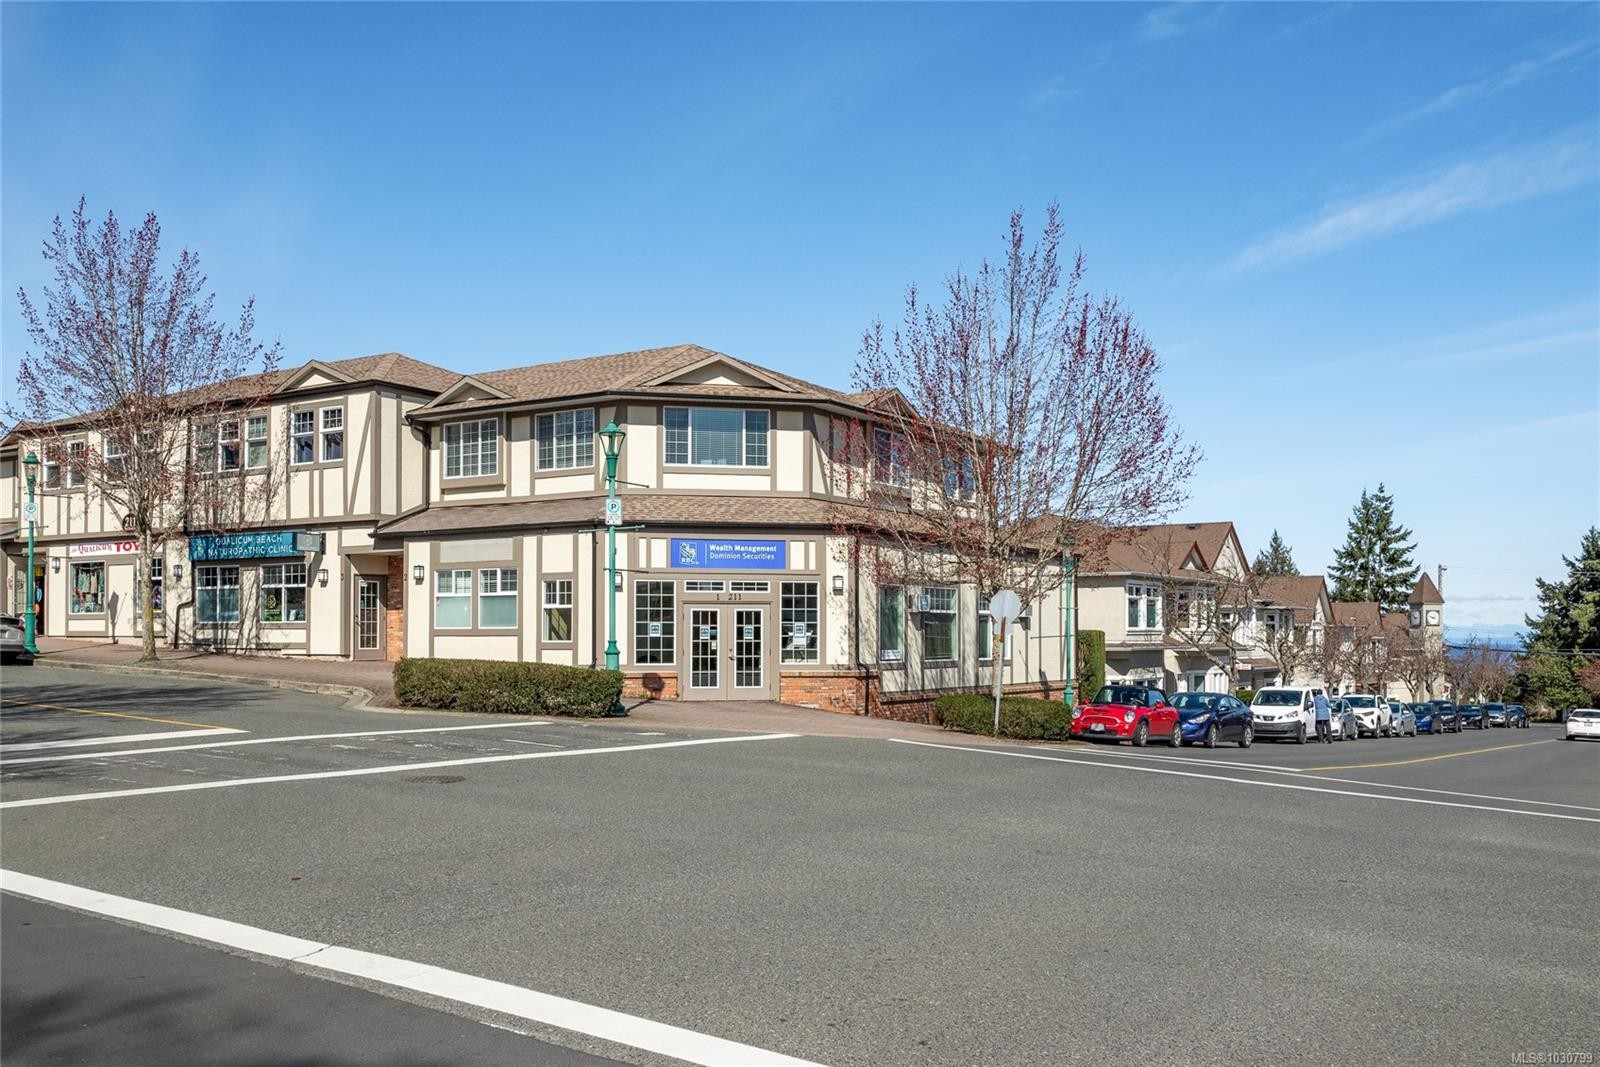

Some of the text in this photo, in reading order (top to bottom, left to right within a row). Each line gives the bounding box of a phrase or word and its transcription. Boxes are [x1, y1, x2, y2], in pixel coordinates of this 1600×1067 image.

[215, 534, 282, 545] QUALICUM BEACH
[208, 544, 293, 556] NATUROPATHIC CLINIC
[709, 543, 777, 553] Wealth Management
[709, 552, 775, 561] Dominion Securities
[728, 593, 742, 601] 211
